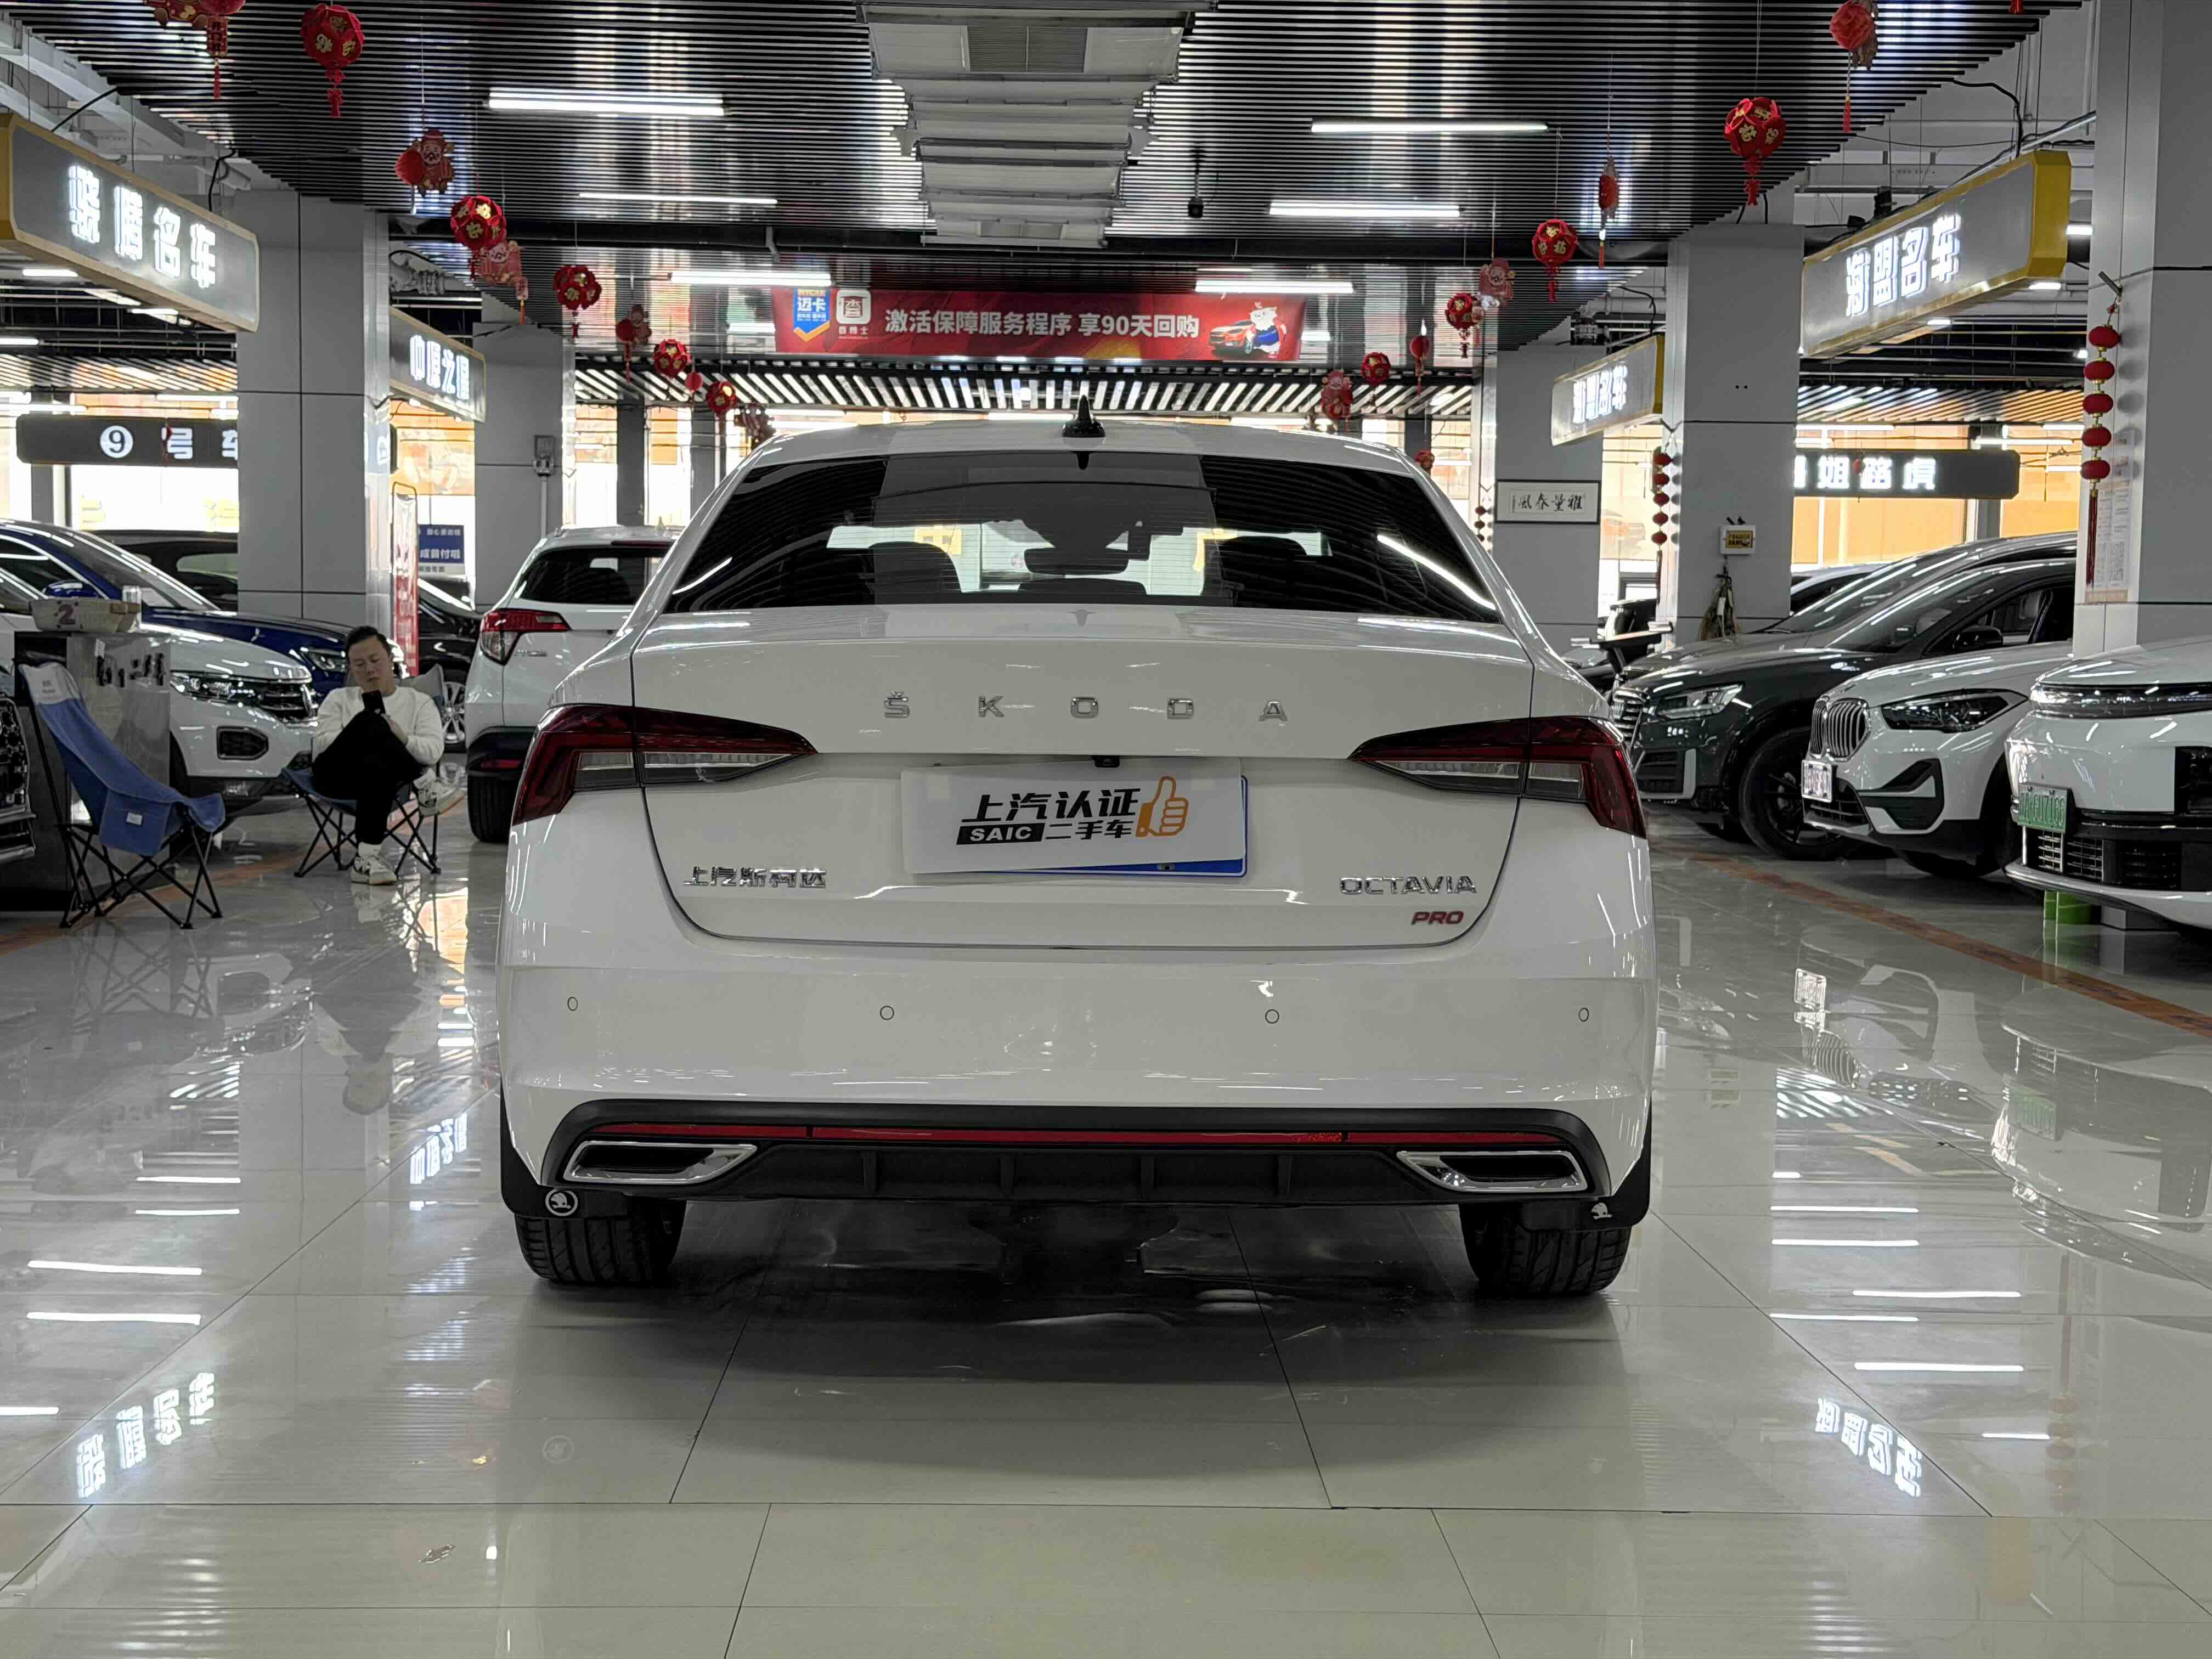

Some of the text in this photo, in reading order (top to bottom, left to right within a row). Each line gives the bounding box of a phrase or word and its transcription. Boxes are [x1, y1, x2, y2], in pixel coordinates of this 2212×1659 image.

[797, 297, 826, 312] 迈卡
[885, 309, 1199, 338] 激活保障服务程序 享90天回购
[884, 690, 1288, 721] ŠKODA
[962, 788, 1141, 822] 上汽认证
[970, 819, 1134, 842] SAIC 二手车
[682, 866, 827, 888] 上汽斯柯达
[1339, 876, 1477, 895] OCTAVIA
[1412, 910, 1464, 926] PRO
